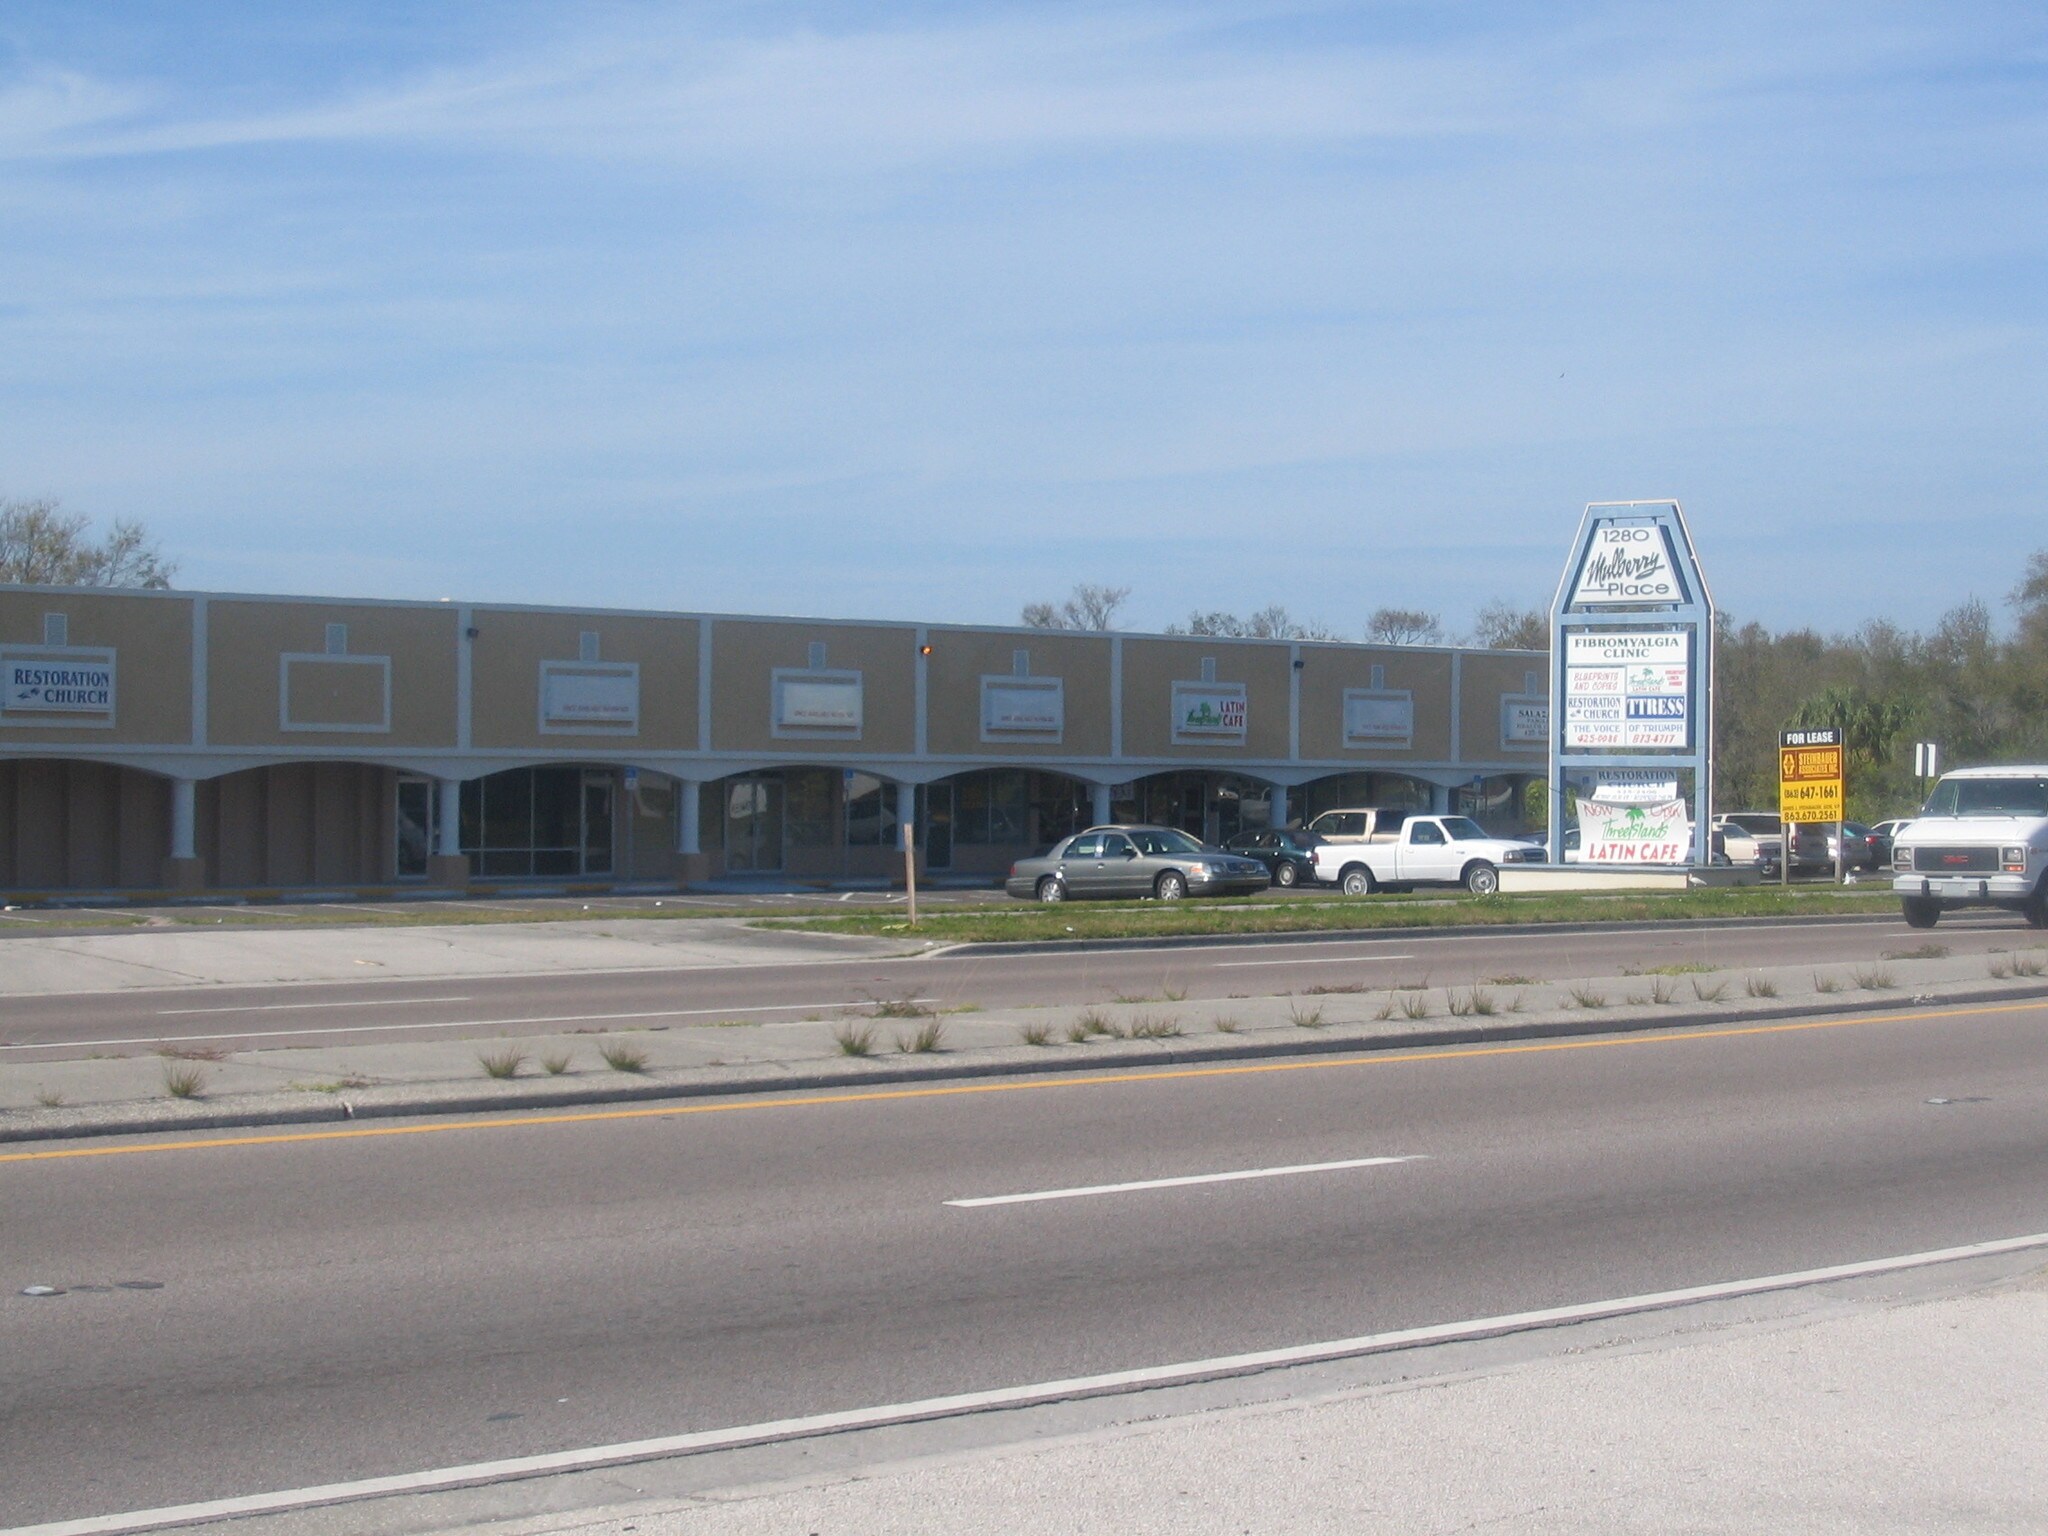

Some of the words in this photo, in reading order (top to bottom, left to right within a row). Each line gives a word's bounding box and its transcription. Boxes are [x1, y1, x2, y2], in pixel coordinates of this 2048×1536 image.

[1602, 529, 1649, 543] 1280
[1587, 547, 1665, 588] Mulberry
[1608, 582, 1669, 596] Place
[1574, 637, 1679, 648] FIBROMYALGIA
[1603, 648, 1650, 658] CLINIC
[14, 668, 109, 687] RESTORATION
[1573, 682, 1590, 691] AND
[44, 689, 108, 704] CHURCH
[1568, 697, 1621, 708] RESTORATION
[1220, 701, 1245, 713] LATIN
[1583, 709, 1620, 719] CHURCH
[1223, 714, 1243, 727] CAFE
[1573, 725, 1591, 733] THE
[1594, 724, 1620, 733] VOICE
[1628, 724, 1640, 732] OF
[1643, 724, 1683, 732] TRIUMPH
[1786, 733, 1805, 745] FOR
[1806, 731, 1834, 744] LEASE
[1598, 770, 1676, 780] RESTORATION
[1588, 843, 1636, 860] LATIN
[1640, 843, 1679, 860] CAFE
